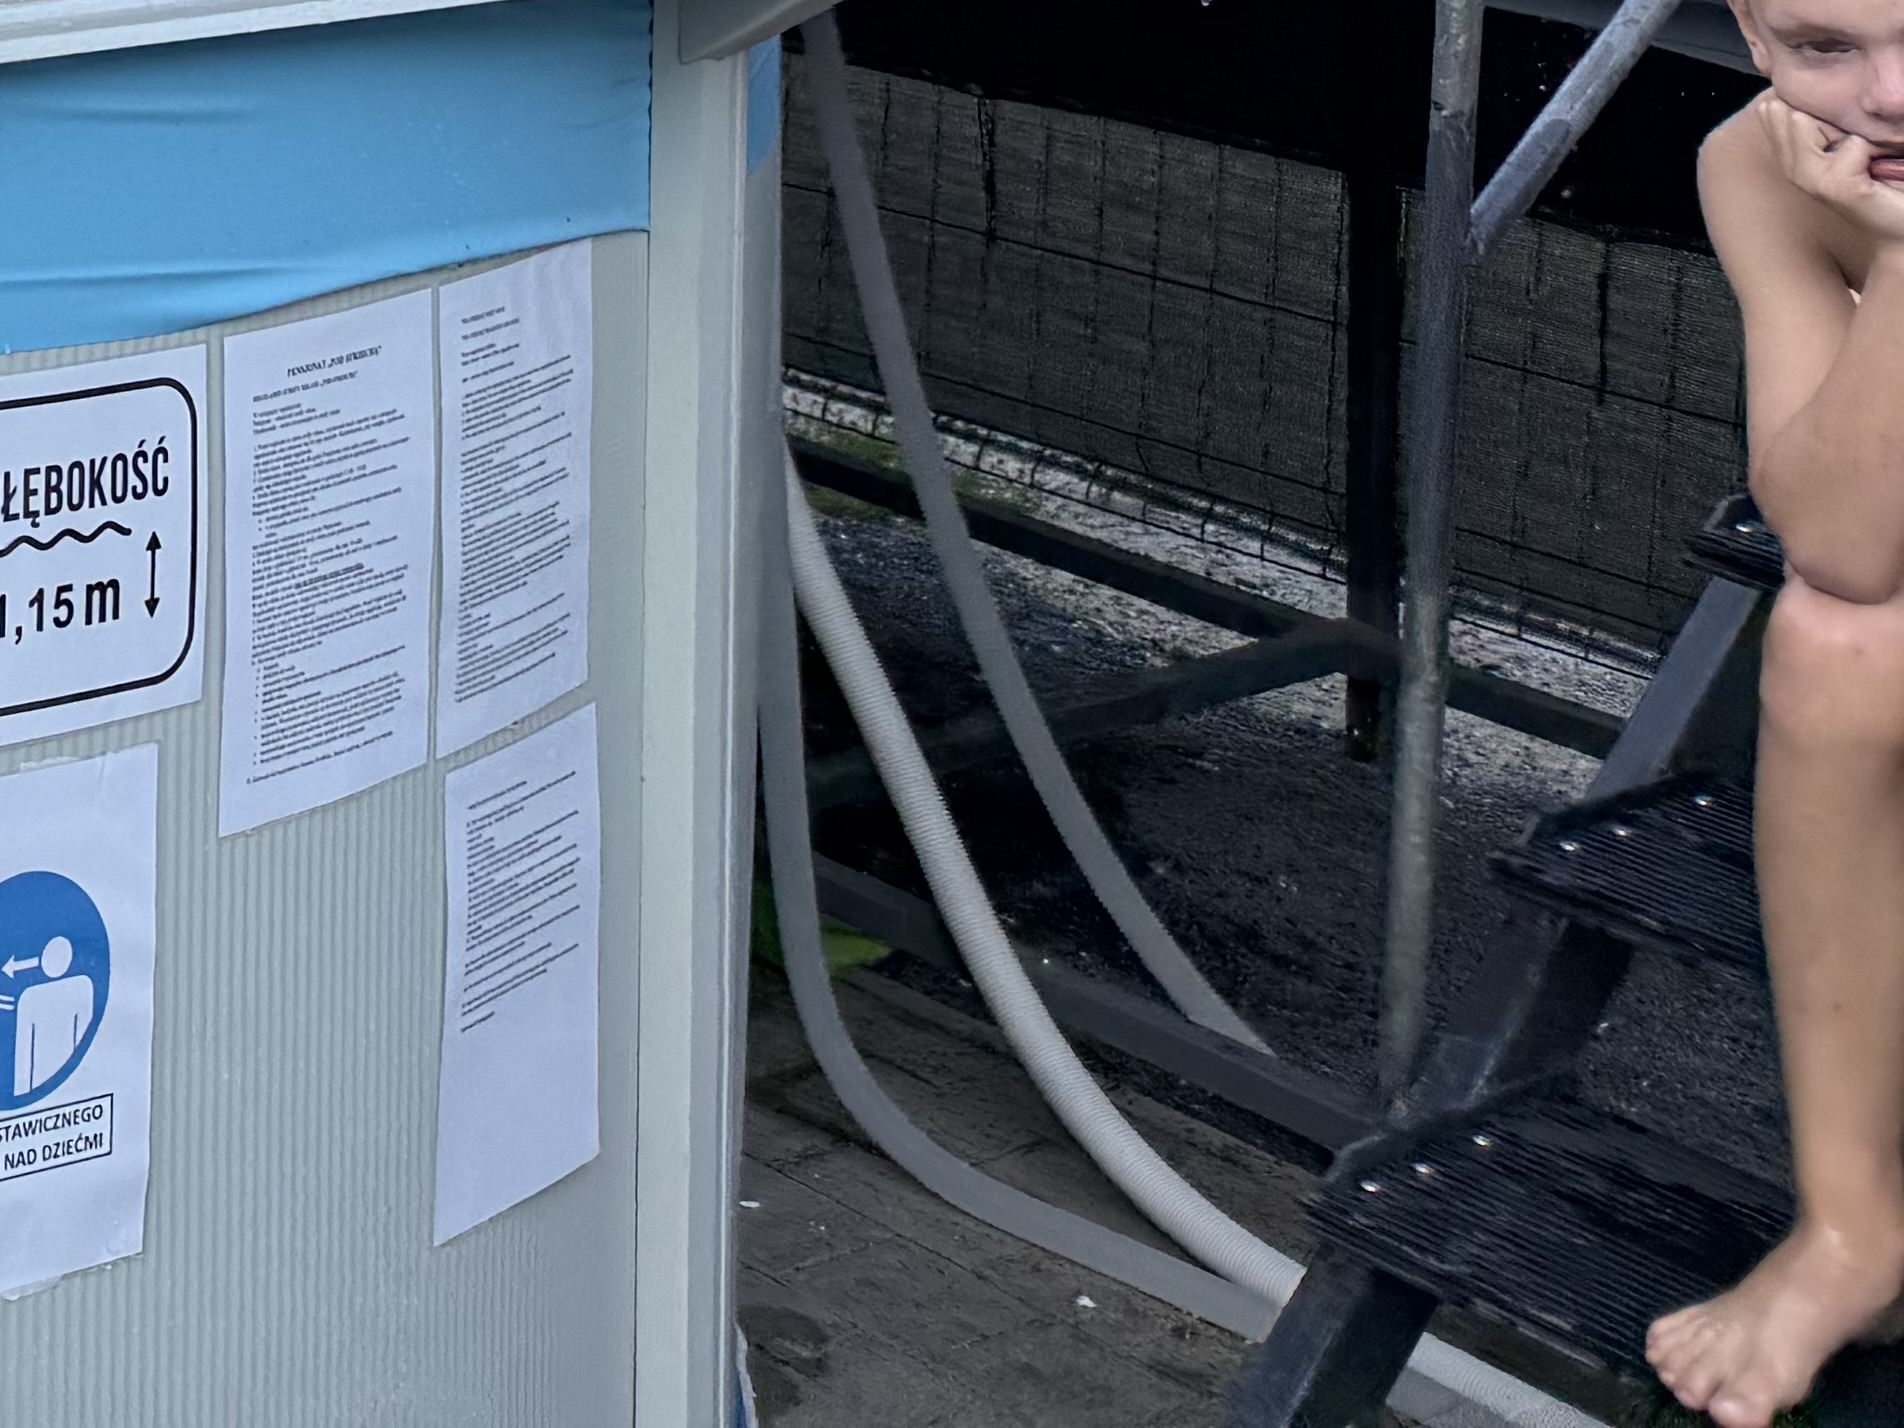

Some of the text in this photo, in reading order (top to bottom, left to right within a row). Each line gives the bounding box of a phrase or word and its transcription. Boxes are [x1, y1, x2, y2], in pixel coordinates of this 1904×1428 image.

[85, 578, 121, 626] m
[4, 1149, 37, 1170] NAD
[42, 1132, 103, 1161] DZIEĆMI
